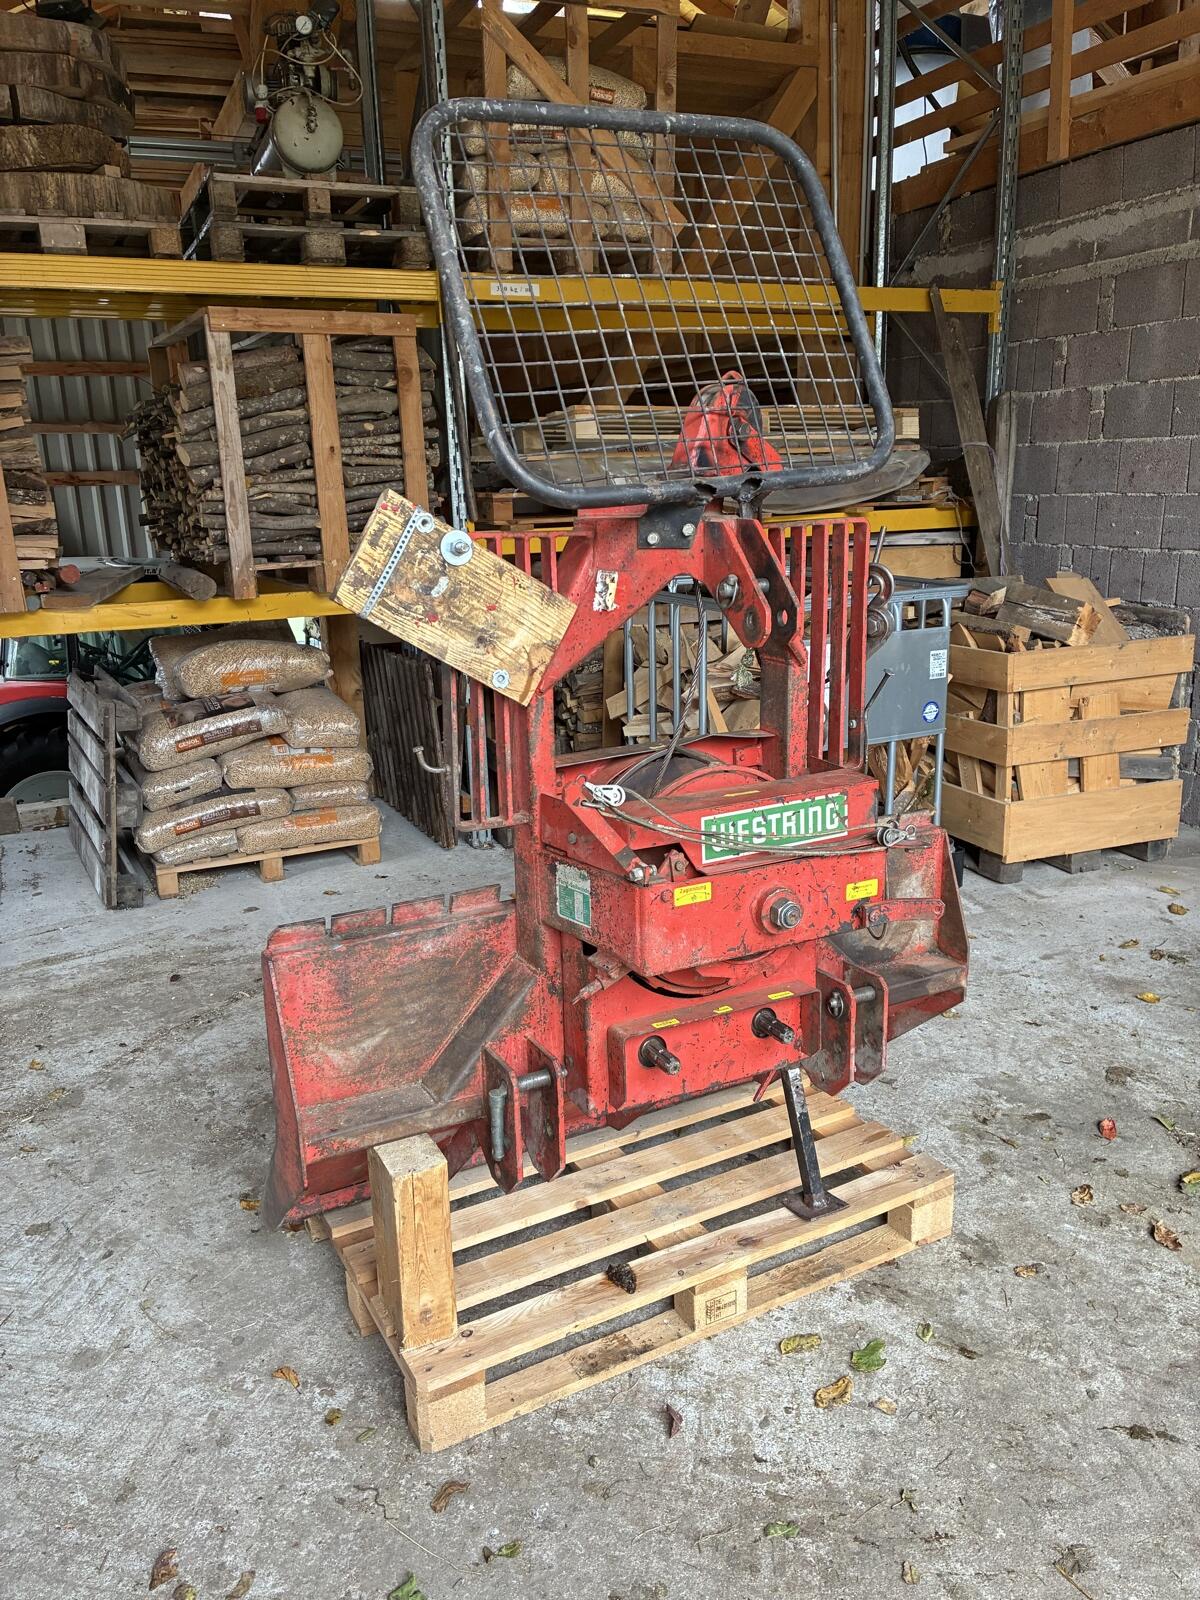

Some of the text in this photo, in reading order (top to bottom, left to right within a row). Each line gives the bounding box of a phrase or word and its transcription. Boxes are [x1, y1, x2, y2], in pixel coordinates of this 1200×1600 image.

[178, 738, 200, 748] GENOL
[176, 821, 199, 831] GENOL
[711, 802, 839, 852] WESTRING
